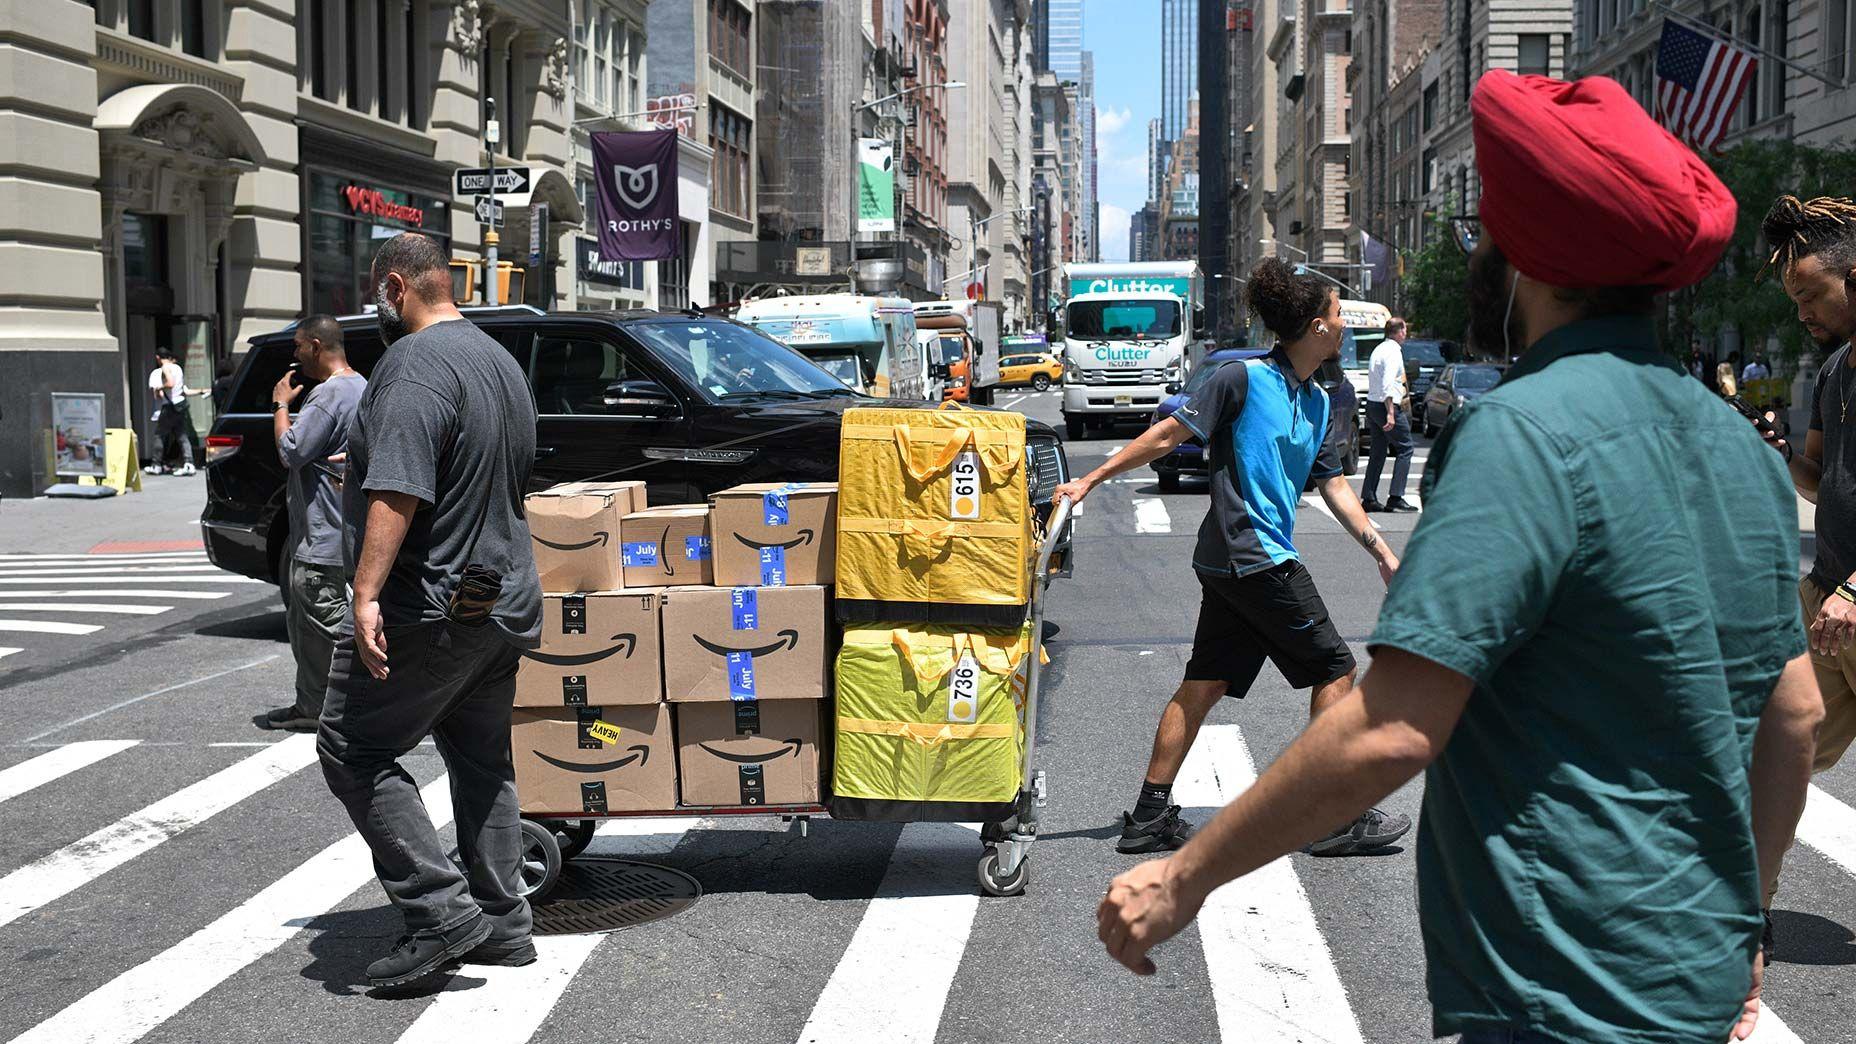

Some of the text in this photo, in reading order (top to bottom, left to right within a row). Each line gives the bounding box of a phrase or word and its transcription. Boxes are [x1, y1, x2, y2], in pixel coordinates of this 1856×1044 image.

[464, 175, 518, 188] ONE WAY
[607, 218, 673, 232] ROTHY'S
[1089, 279, 1175, 294] Clutter
[1095, 347, 1151, 361] Clutter
[955, 464, 974, 496] 615
[635, 544, 657, 557] July
[741, 667, 753, 689] July
[953, 668, 974, 700] 736
[592, 724, 619, 740] HEAVY
